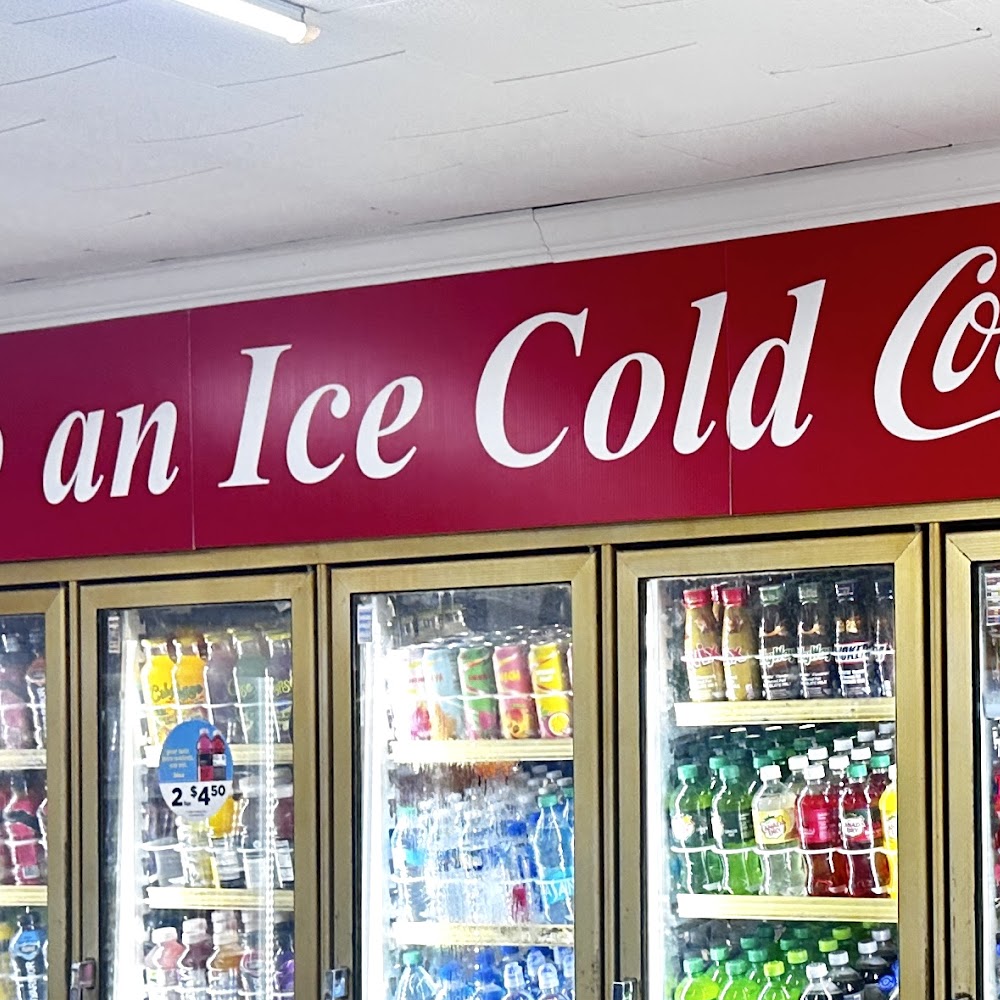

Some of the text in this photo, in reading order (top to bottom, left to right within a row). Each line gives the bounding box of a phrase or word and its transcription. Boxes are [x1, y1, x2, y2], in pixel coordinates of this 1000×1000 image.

[43, 401, 180, 505] an
[218, 344, 424, 488] Ice
[475, 279, 826, 469] Cold
[171, 787, 182, 806] 2
